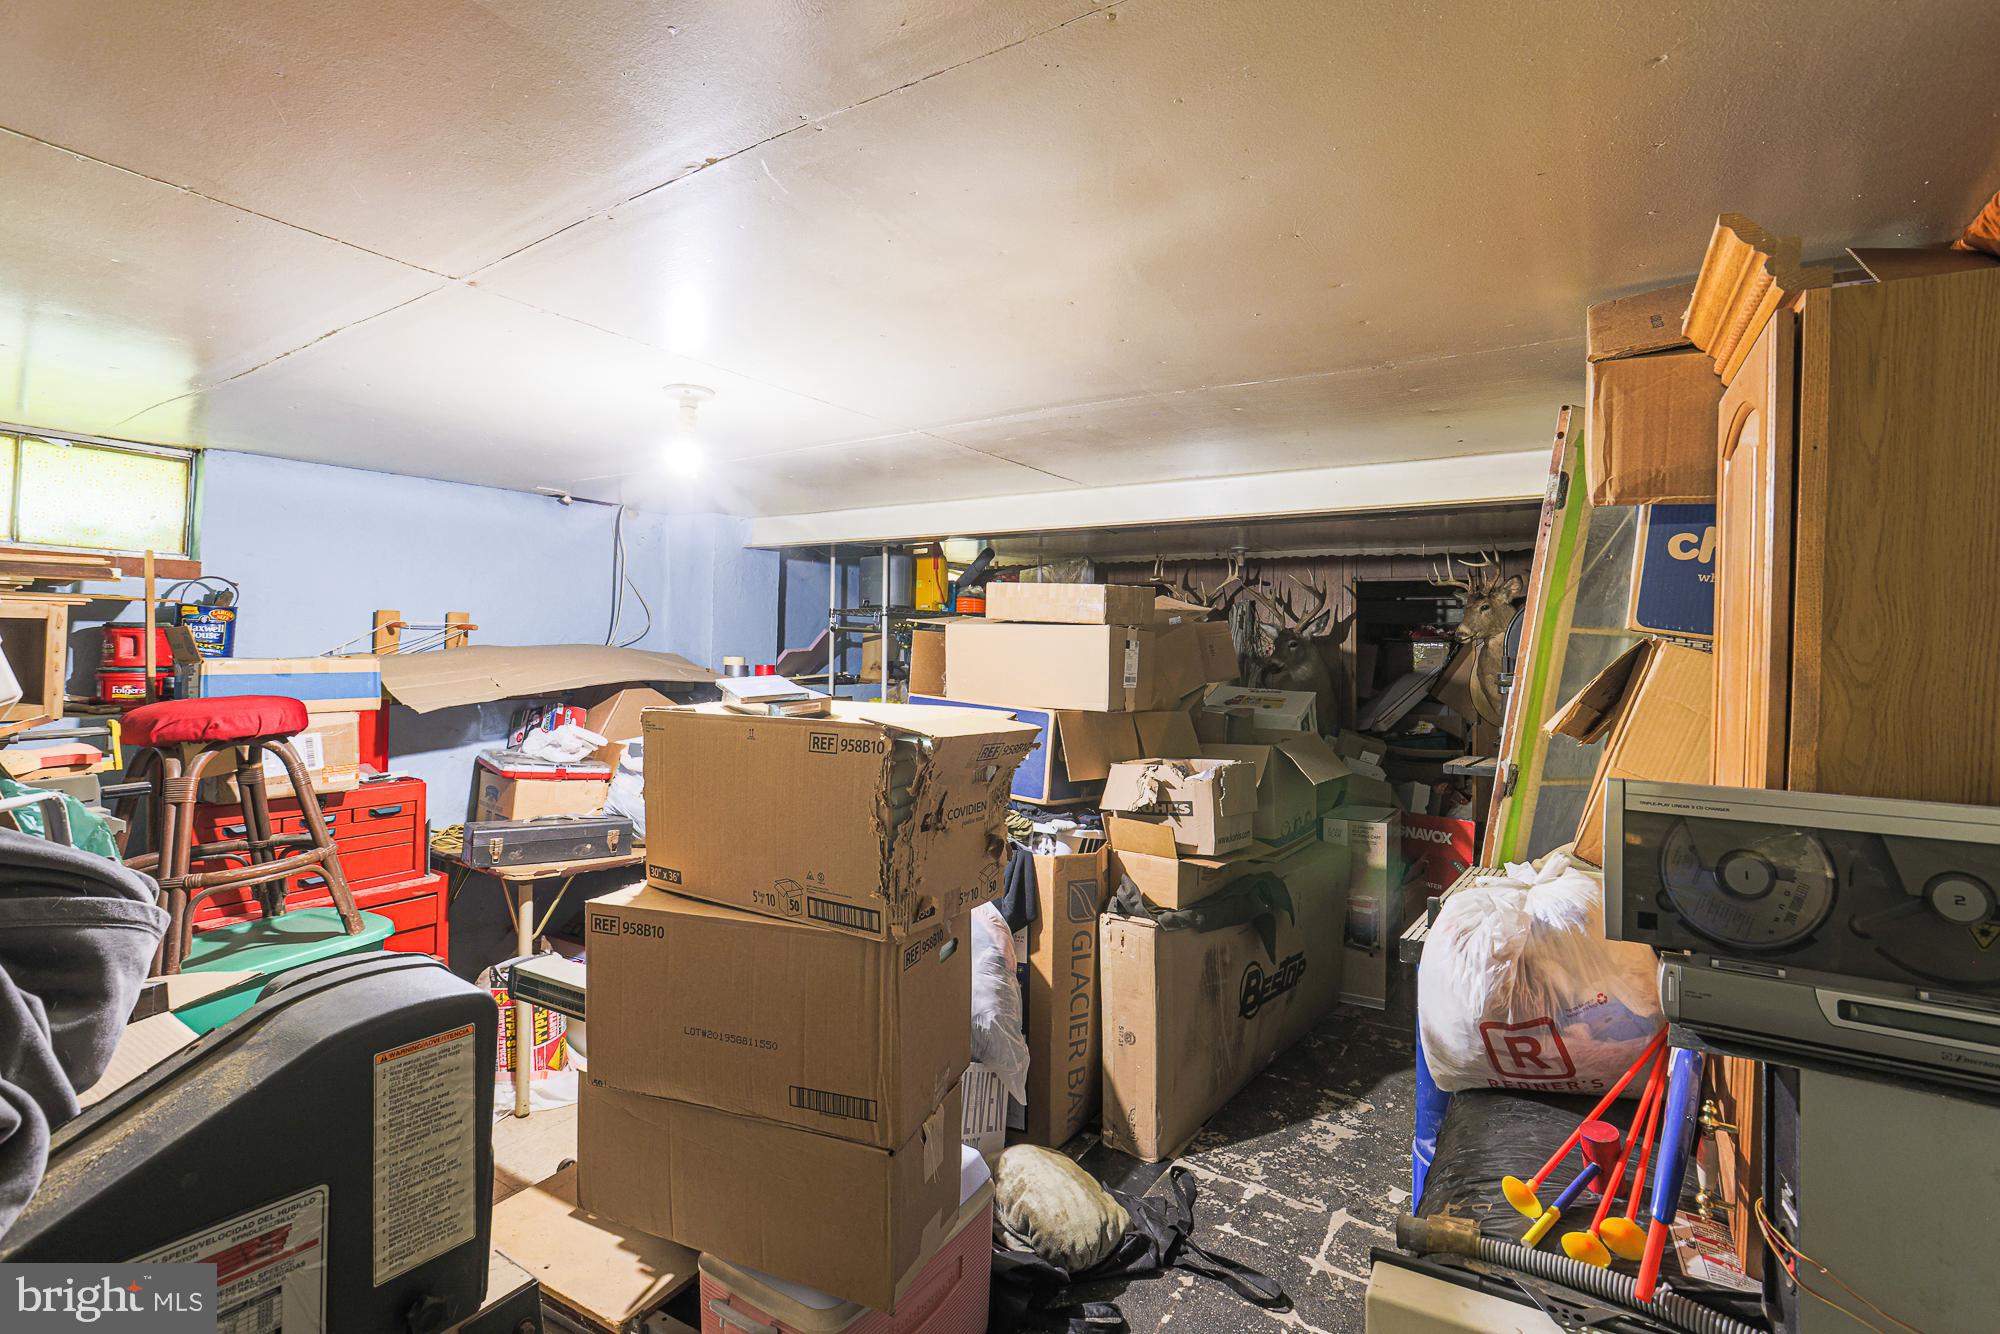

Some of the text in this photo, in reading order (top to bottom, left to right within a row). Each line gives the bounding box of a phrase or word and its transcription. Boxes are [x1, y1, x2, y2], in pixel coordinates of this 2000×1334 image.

[190, 623, 224, 633] axwell
[194, 631, 220, 640] ouse
[112, 685, 146, 695] Folgers
[812, 736, 885, 755] REF 958B10
[981, 745, 1001, 758] REF
[947, 802, 987, 820] COVIDIEN
[1136, 803, 1191, 814] OHL'S
[650, 866, 662, 878] 30"
[989, 879, 997, 893] 50
[766, 893, 776, 907] 10
[789, 899, 800, 912] 50
[1953, 894, 1967, 906] 2
[594, 917, 665, 940] REF 958B10
[906, 946, 919, 967] REF
[1070, 930, 1094, 1062] GLACIER
[1502, 1035, 1545, 1070] R
[1487, 1078, 1604, 1091] REDNER'S
[257, 1213, 276, 1225] DEL
[278, 1197, 316, 1215] HUSILLO
